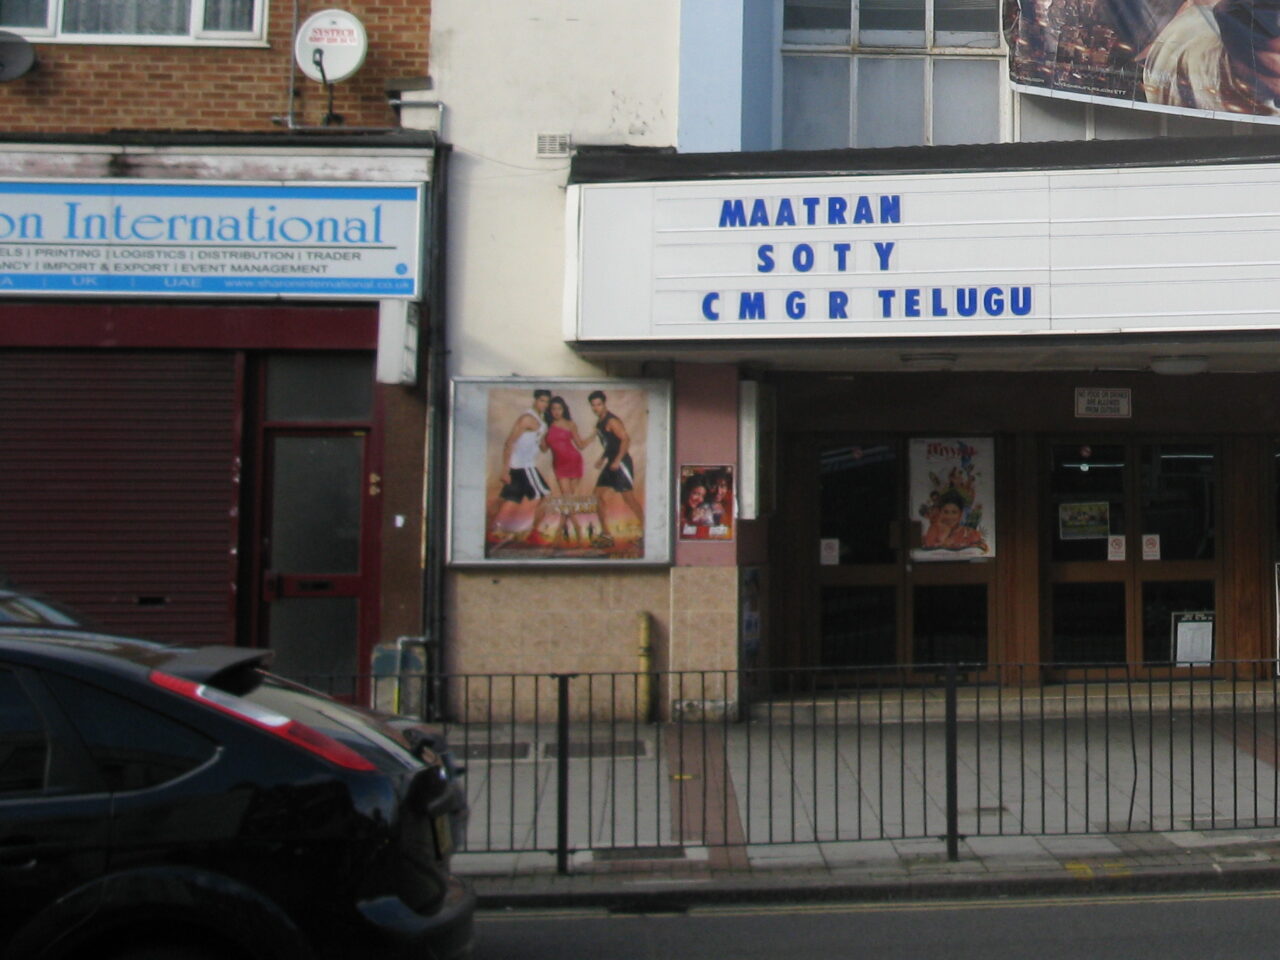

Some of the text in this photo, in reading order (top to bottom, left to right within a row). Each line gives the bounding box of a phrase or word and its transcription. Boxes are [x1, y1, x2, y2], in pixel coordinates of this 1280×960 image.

[718, 194, 902, 228] MAATRAN
[64, 201, 385, 245] International
[34, 247, 101, 259] PRINTING
[113, 249, 187, 260] LOGISTICS
[198, 249, 295, 261] DISTRIBUTION
[307, 251, 362, 261] TRADER
[42, 262, 96, 272] IMPORT
[100, 263, 110, 272] &
[113, 263, 170, 273] EXPORT
[181, 264, 227, 273] EVENT
[230, 264, 329, 274] MANAGEMENT
[71, 276, 99, 287] UK
[164, 277, 201, 288] UAE
[877, 286, 1034, 318] TELUGU
